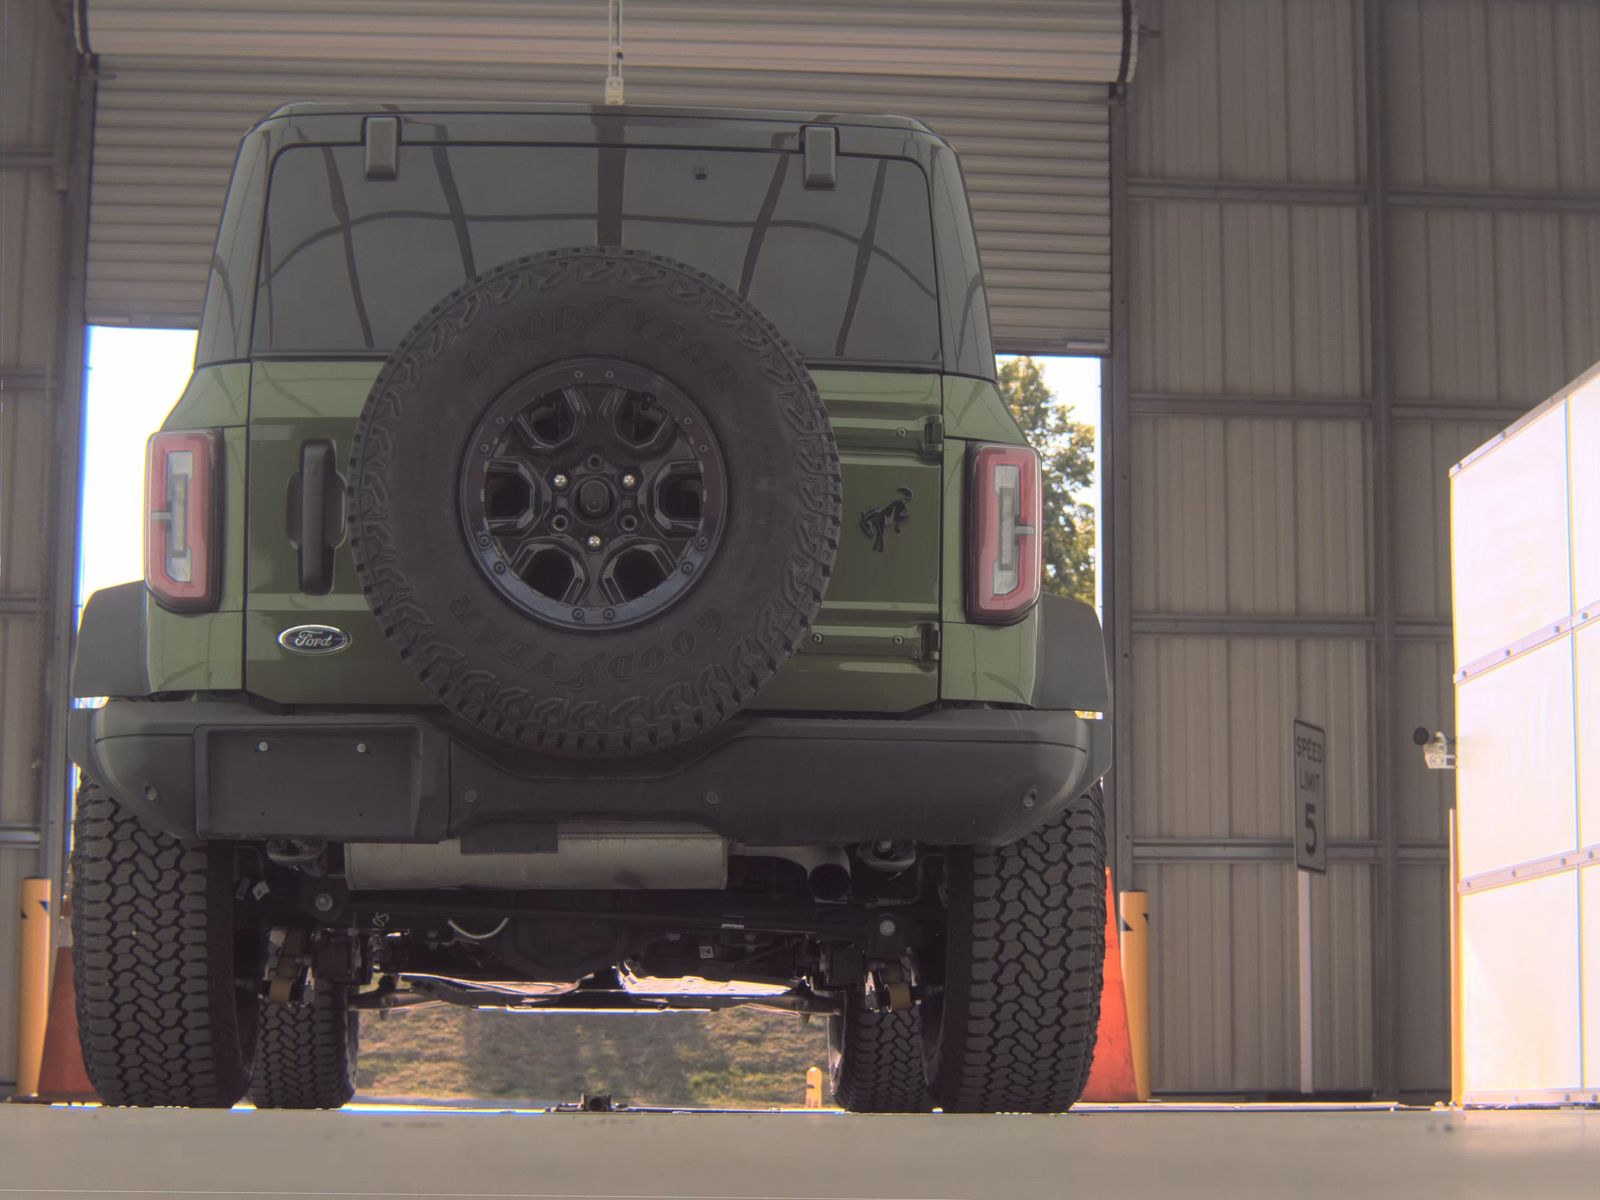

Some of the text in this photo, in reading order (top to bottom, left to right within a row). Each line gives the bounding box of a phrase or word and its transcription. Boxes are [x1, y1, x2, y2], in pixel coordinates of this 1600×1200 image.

[294, 629, 333, 648] Ford
[1296, 735, 1322, 764] SPEED
[1299, 768, 1320, 796] LIMIT
[1304, 802, 1318, 858] 5
